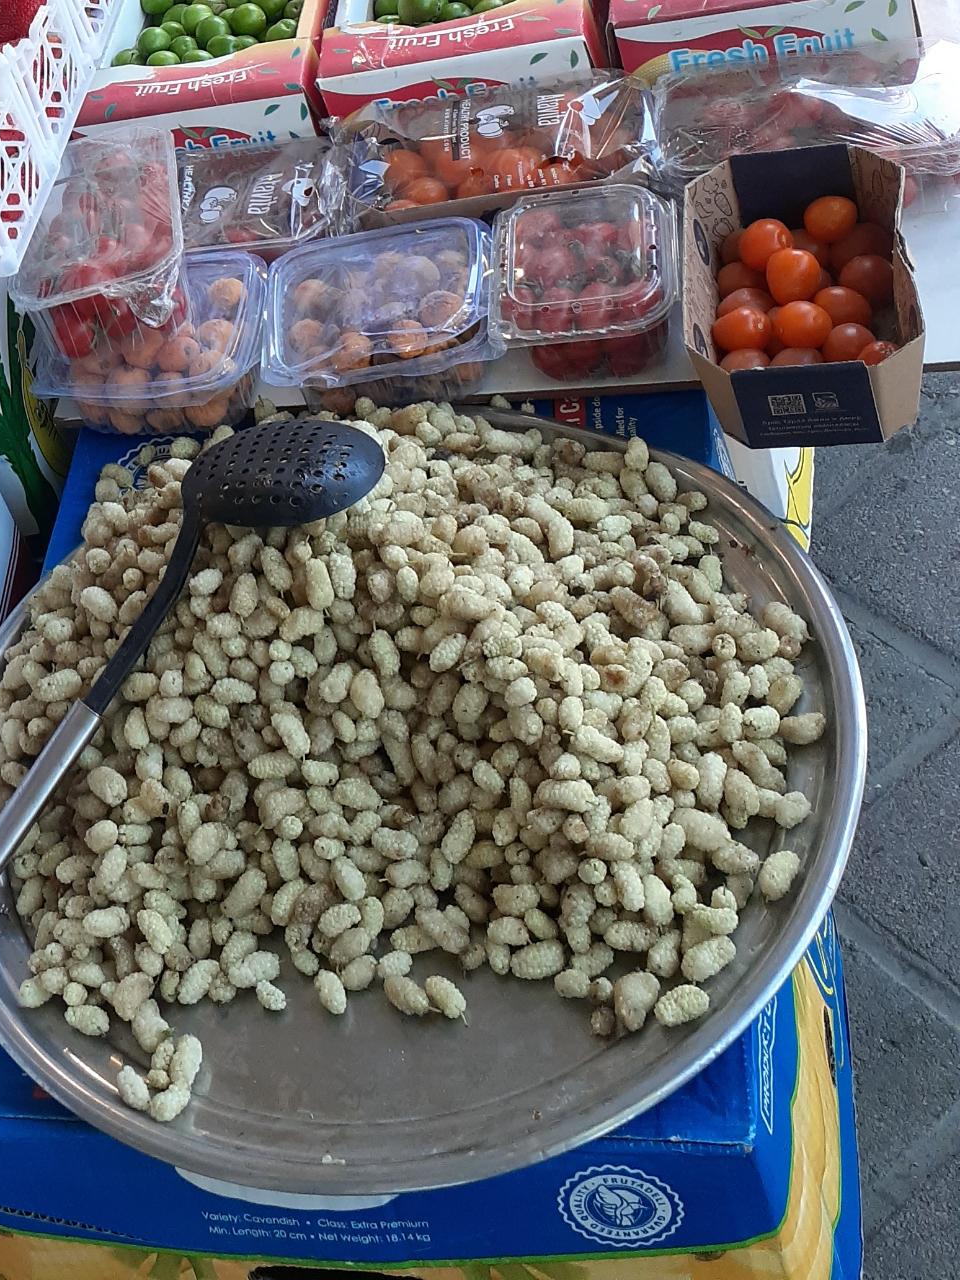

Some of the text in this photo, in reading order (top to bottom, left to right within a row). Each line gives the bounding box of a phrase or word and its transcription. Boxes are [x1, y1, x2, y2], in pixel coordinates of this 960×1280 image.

[389, 18, 515, 50] Fresh Fruit
[669, 26, 856, 73] Fresh Fruit
[135, 69, 247, 97] Fresh Fruit
[460, 123, 471, 160] PRODUCT
[602, 1177, 666, 1206] FRUTADELI
[201, 1211, 429, 1230] Variety: Cavendish Class: Extra Premium
[573, 1185, 666, 1238] GUARANTEED QUALITY
[209, 1226, 431, 1245] Min. Length: 20 cm Net Weight: 18.14 kg
